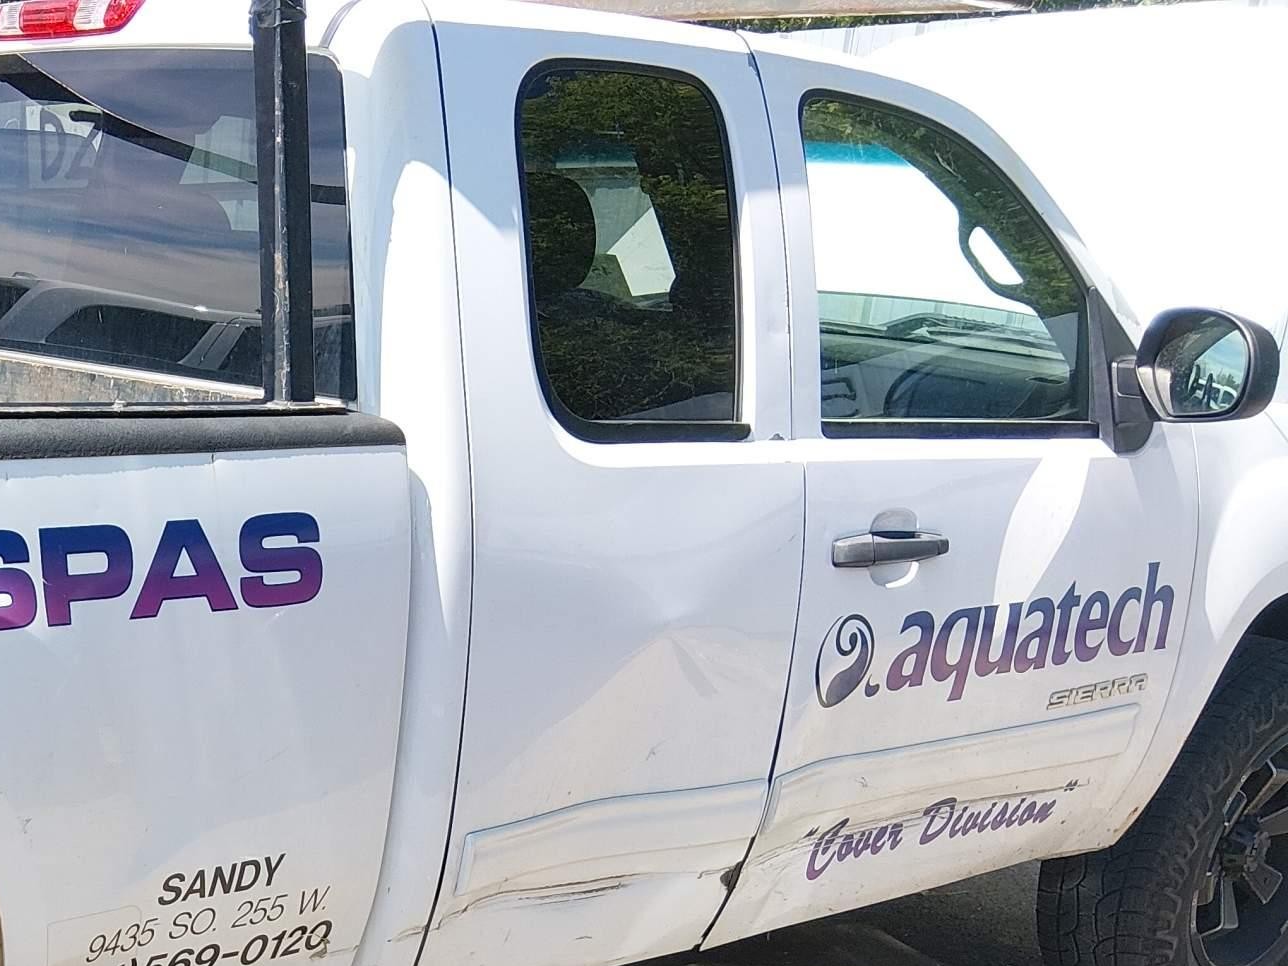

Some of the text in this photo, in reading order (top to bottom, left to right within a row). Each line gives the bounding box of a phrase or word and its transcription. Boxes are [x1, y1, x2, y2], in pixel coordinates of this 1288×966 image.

[885, 561, 1175, 701] aquatech
[1046, 673, 1149, 710] SIERRA
[158, 853, 287, 906] SANDY
[86, 885, 331, 963] 9435 SO. 255 W.
